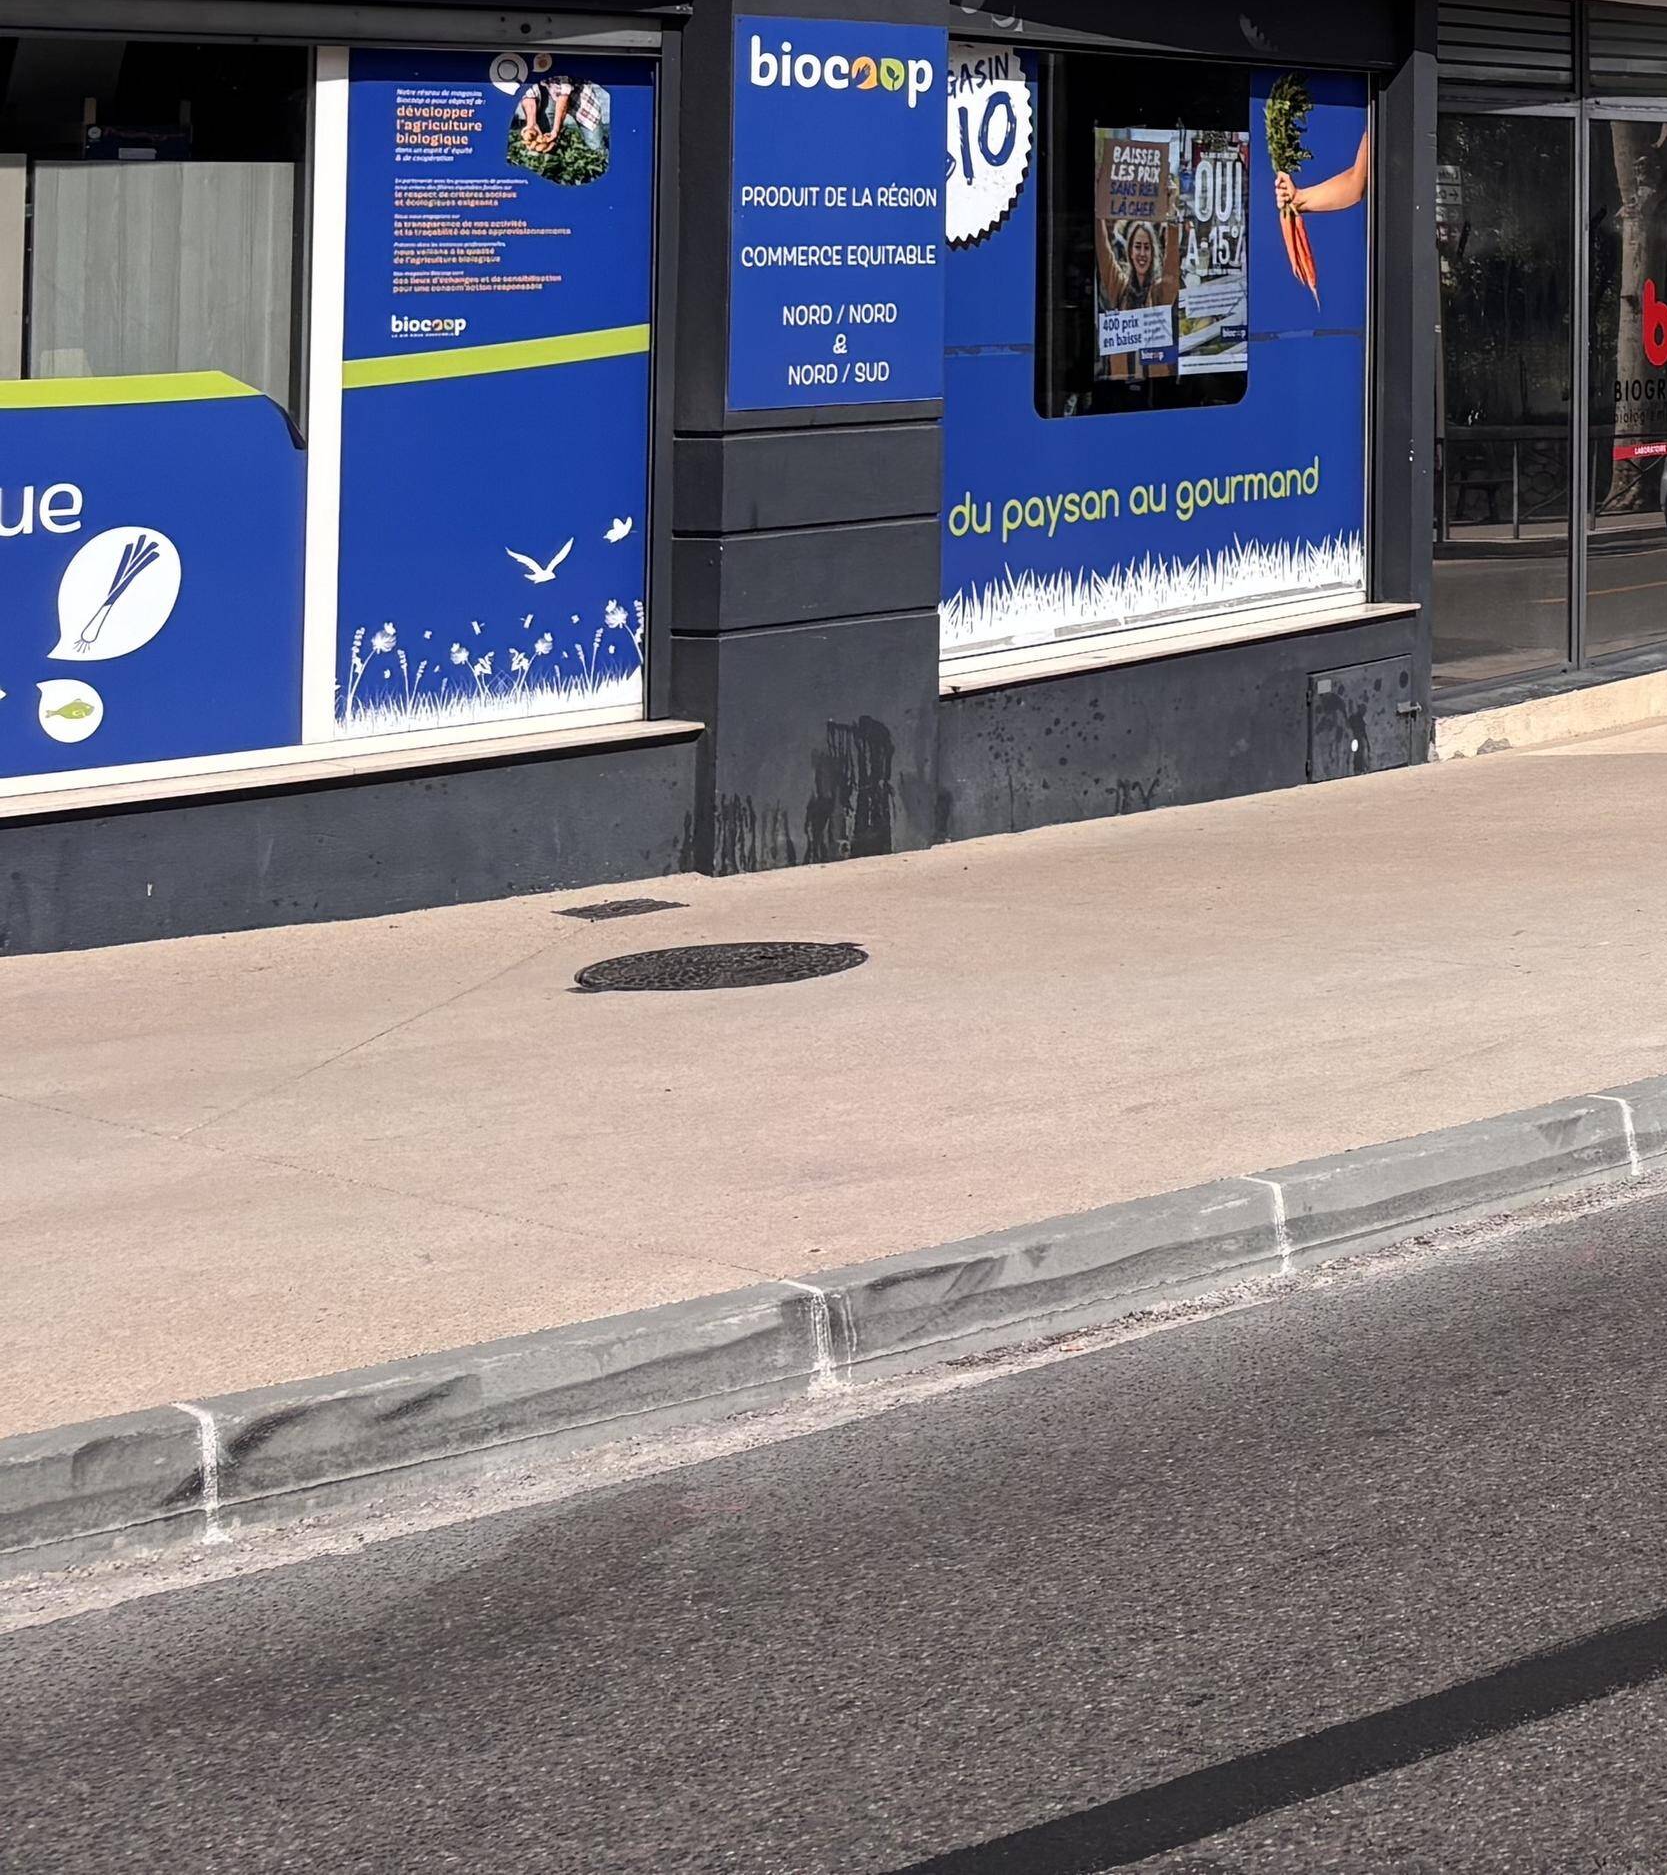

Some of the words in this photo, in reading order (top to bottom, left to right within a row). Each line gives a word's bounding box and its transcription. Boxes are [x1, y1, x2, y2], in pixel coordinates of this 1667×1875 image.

[749, 34, 934, 109] biocoop
[947, 53, 1009, 99] GASIN
[396, 105, 475, 119] développer
[396, 119, 483, 133] l'agriculture
[396, 133, 469, 146] biologique
[947, 91, 1017, 186] IO
[1113, 146, 1161, 166] BAISSER
[1110, 164, 1135, 181] LES
[1137, 165, 1161, 183] PRIX
[741, 186, 820, 207] PRODUIT
[824, 186, 847, 207] DE
[851, 187, 873, 207] LA
[876, 182, 937, 208] RÉGION
[741, 245, 843, 268] COMMERCE
[846, 244, 936, 267] EQUITABLE
[391, 314, 467, 336] biocoop
[782, 304, 833, 327] NORD
[849, 302, 897, 324] NORD
[1102, 318, 1119, 332] 400
[1122, 315, 1139, 333] prix
[832, 333, 848, 354] &
[1103, 338, 1115, 348] en
[1116, 332, 1142, 347] baisse
[787, 364, 838, 387] NORD
[854, 361, 890, 384] SUD
[949, 491, 992, 537] du
[1002, 488, 1119, 543] paysan
[1129, 483, 1166, 515] au
[1175, 455, 1319, 521] gourmand
